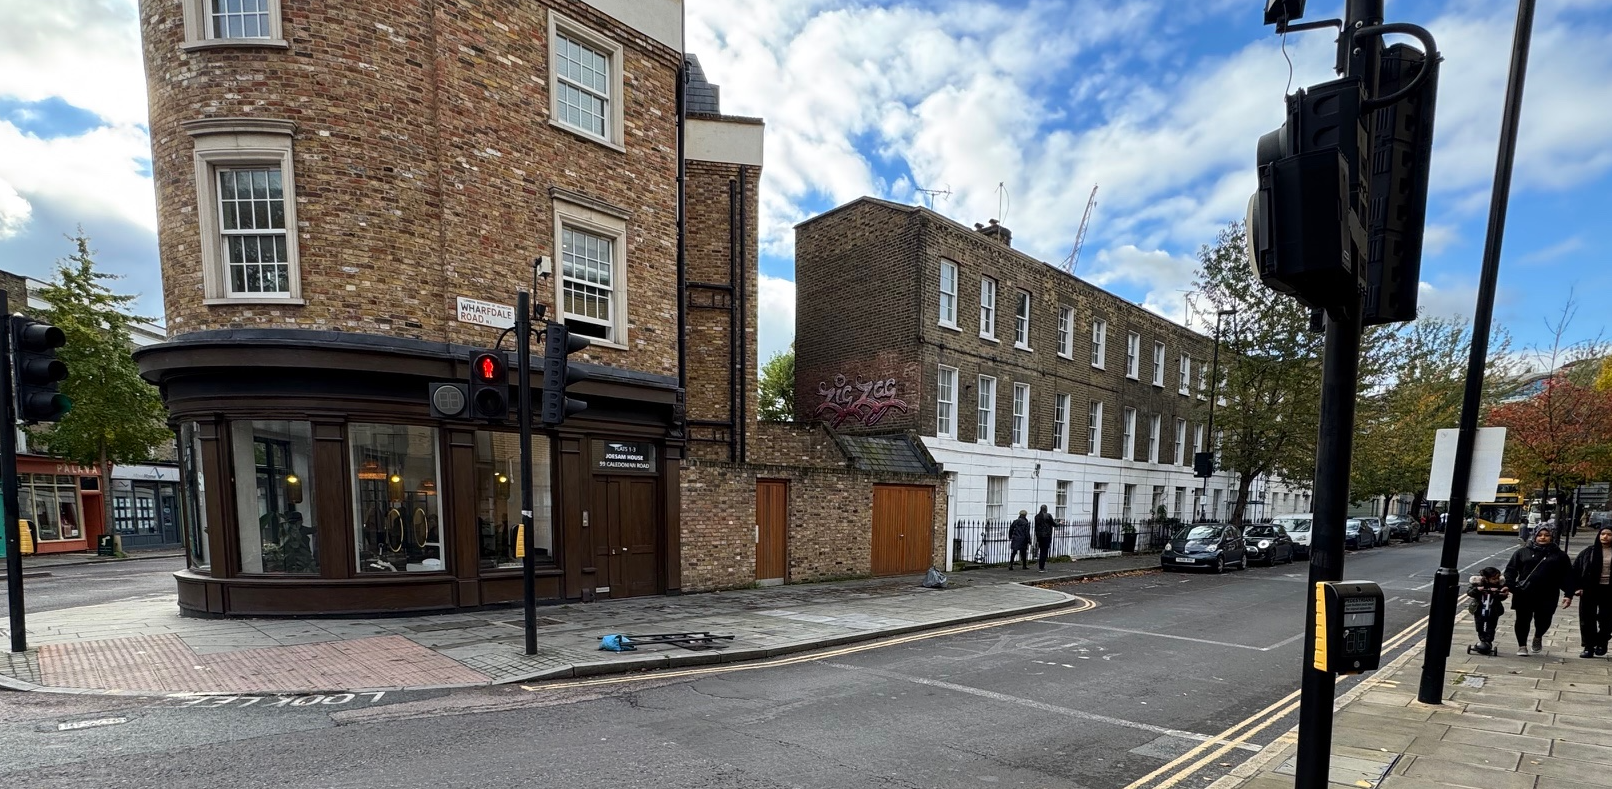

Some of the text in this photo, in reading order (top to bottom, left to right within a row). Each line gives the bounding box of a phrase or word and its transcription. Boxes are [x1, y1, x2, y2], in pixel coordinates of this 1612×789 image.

[460, 303, 512, 319] WHARFDALE
[460, 312, 484, 323] ROAD
[56, 463, 98, 474] PALAVA
[261, 691, 386, 708] LOOK
